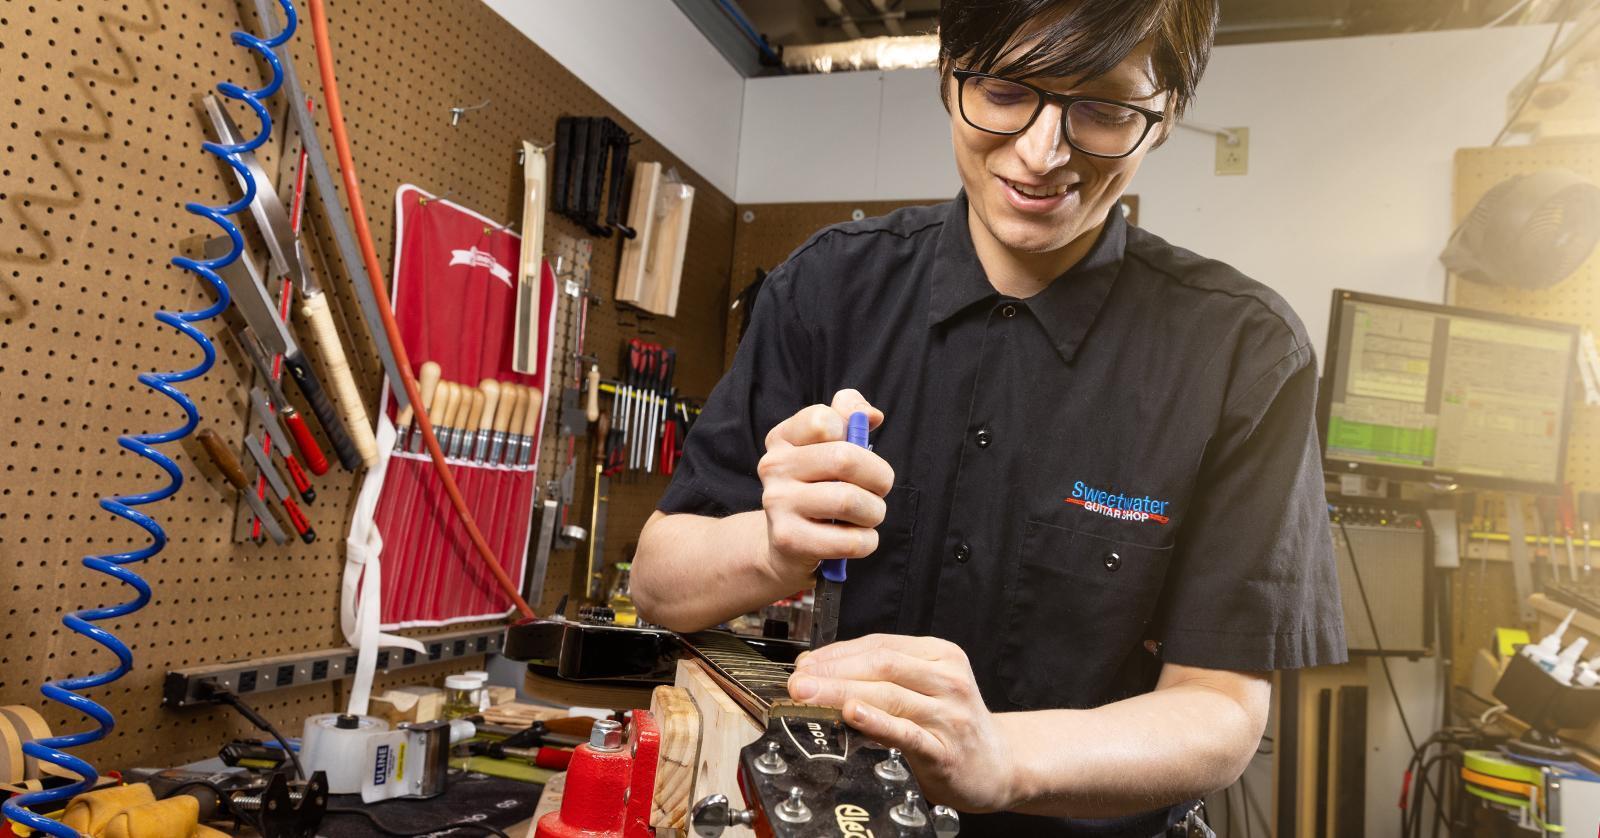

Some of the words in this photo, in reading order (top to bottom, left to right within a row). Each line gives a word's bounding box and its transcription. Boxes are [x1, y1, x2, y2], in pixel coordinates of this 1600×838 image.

[1071, 480, 1169, 515] Sweetwater
[1084, 501, 1120, 519] GUITAR
[1121, 510, 1150, 522] SHOP
[375, 746, 388, 784] ULINE
